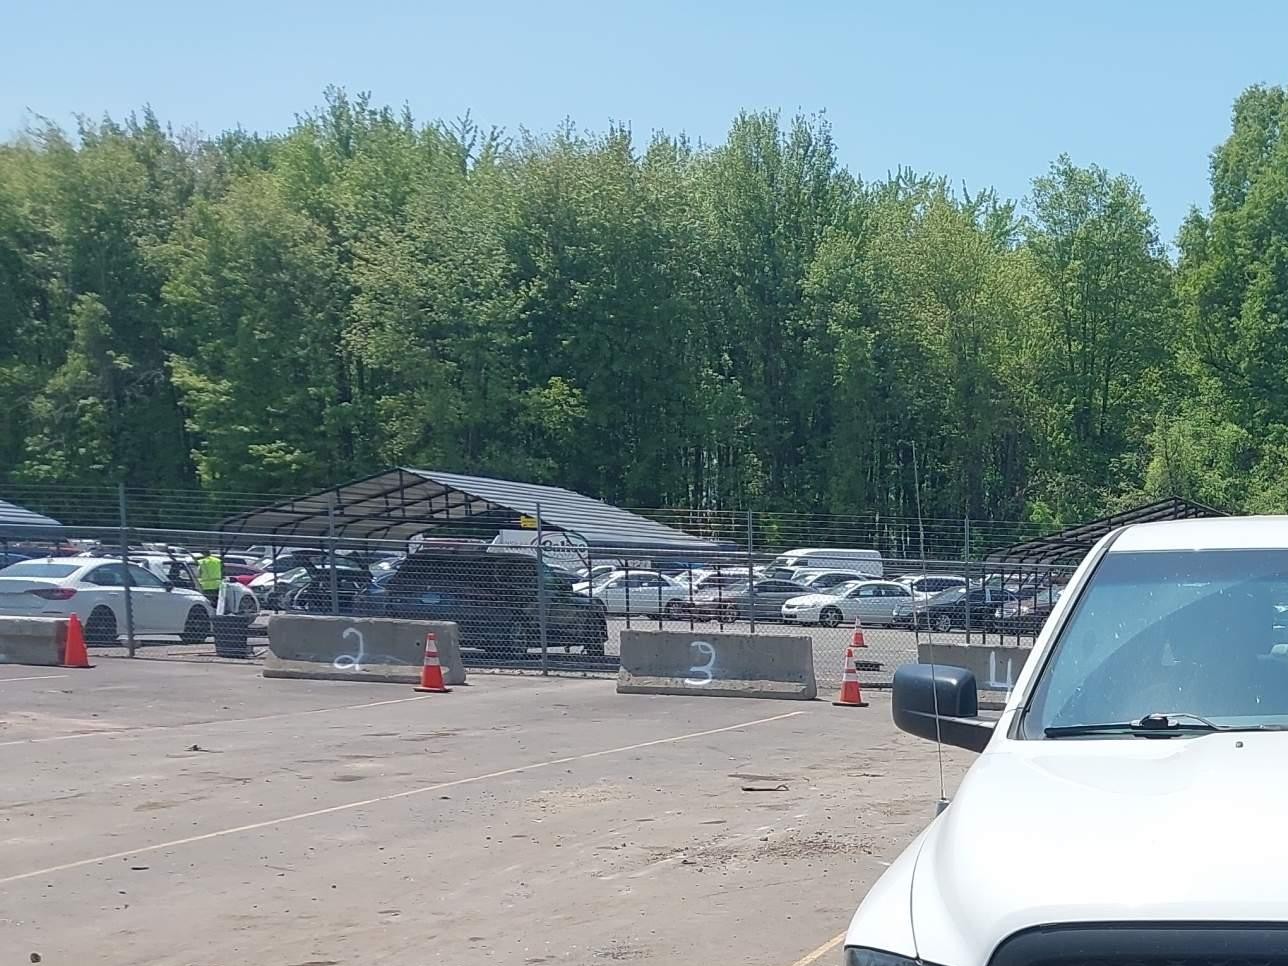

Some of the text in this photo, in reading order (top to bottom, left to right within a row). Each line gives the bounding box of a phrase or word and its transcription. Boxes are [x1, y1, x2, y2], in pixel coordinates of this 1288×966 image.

[333, 627, 364, 671] 2
[684, 640, 716, 685] 3
[987, 650, 1013, 704] 4
